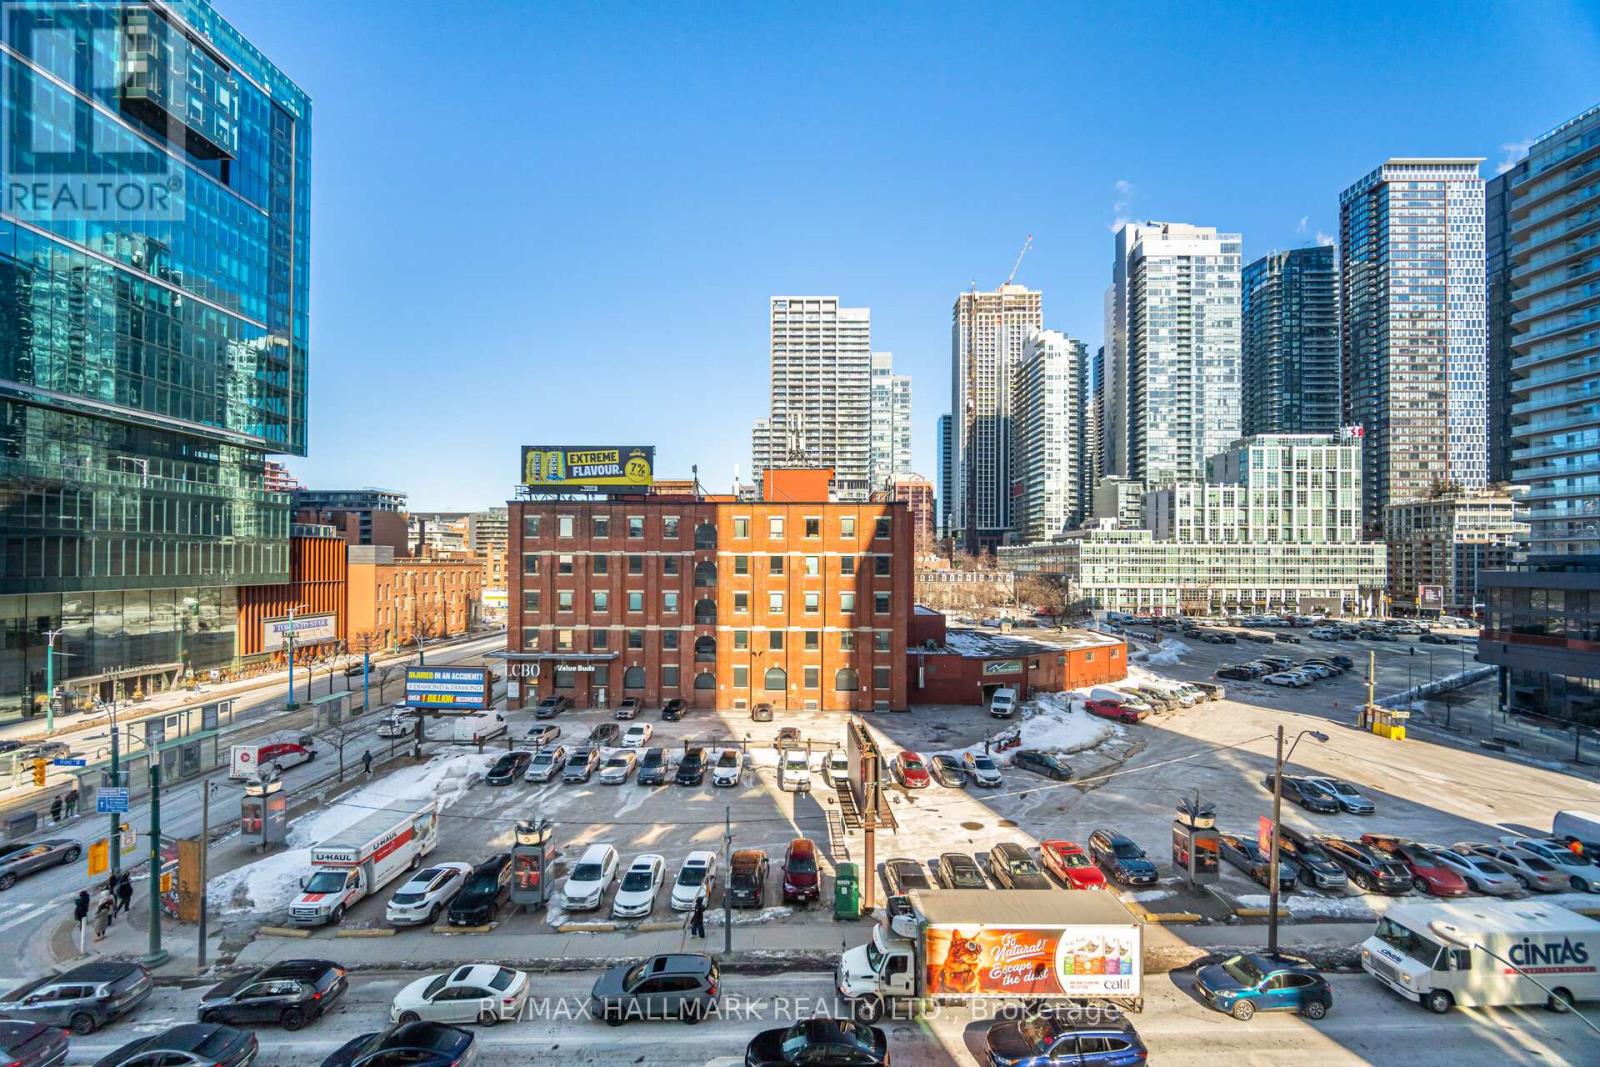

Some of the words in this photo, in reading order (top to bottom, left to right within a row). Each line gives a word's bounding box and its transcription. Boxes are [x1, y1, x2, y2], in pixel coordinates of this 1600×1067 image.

[569, 451, 617, 464] EXTREME
[572, 463, 623, 477] FLAVOUR.
[631, 462, 646, 474] 7%
[504, 663, 541, 677] LCBO
[556, 664, 577, 672] Value
[442, 672, 451, 680] AN
[1001, 932, 1016, 948] Go
[989, 962, 1032, 979] Escape
[1003, 972, 1021, 986] the
